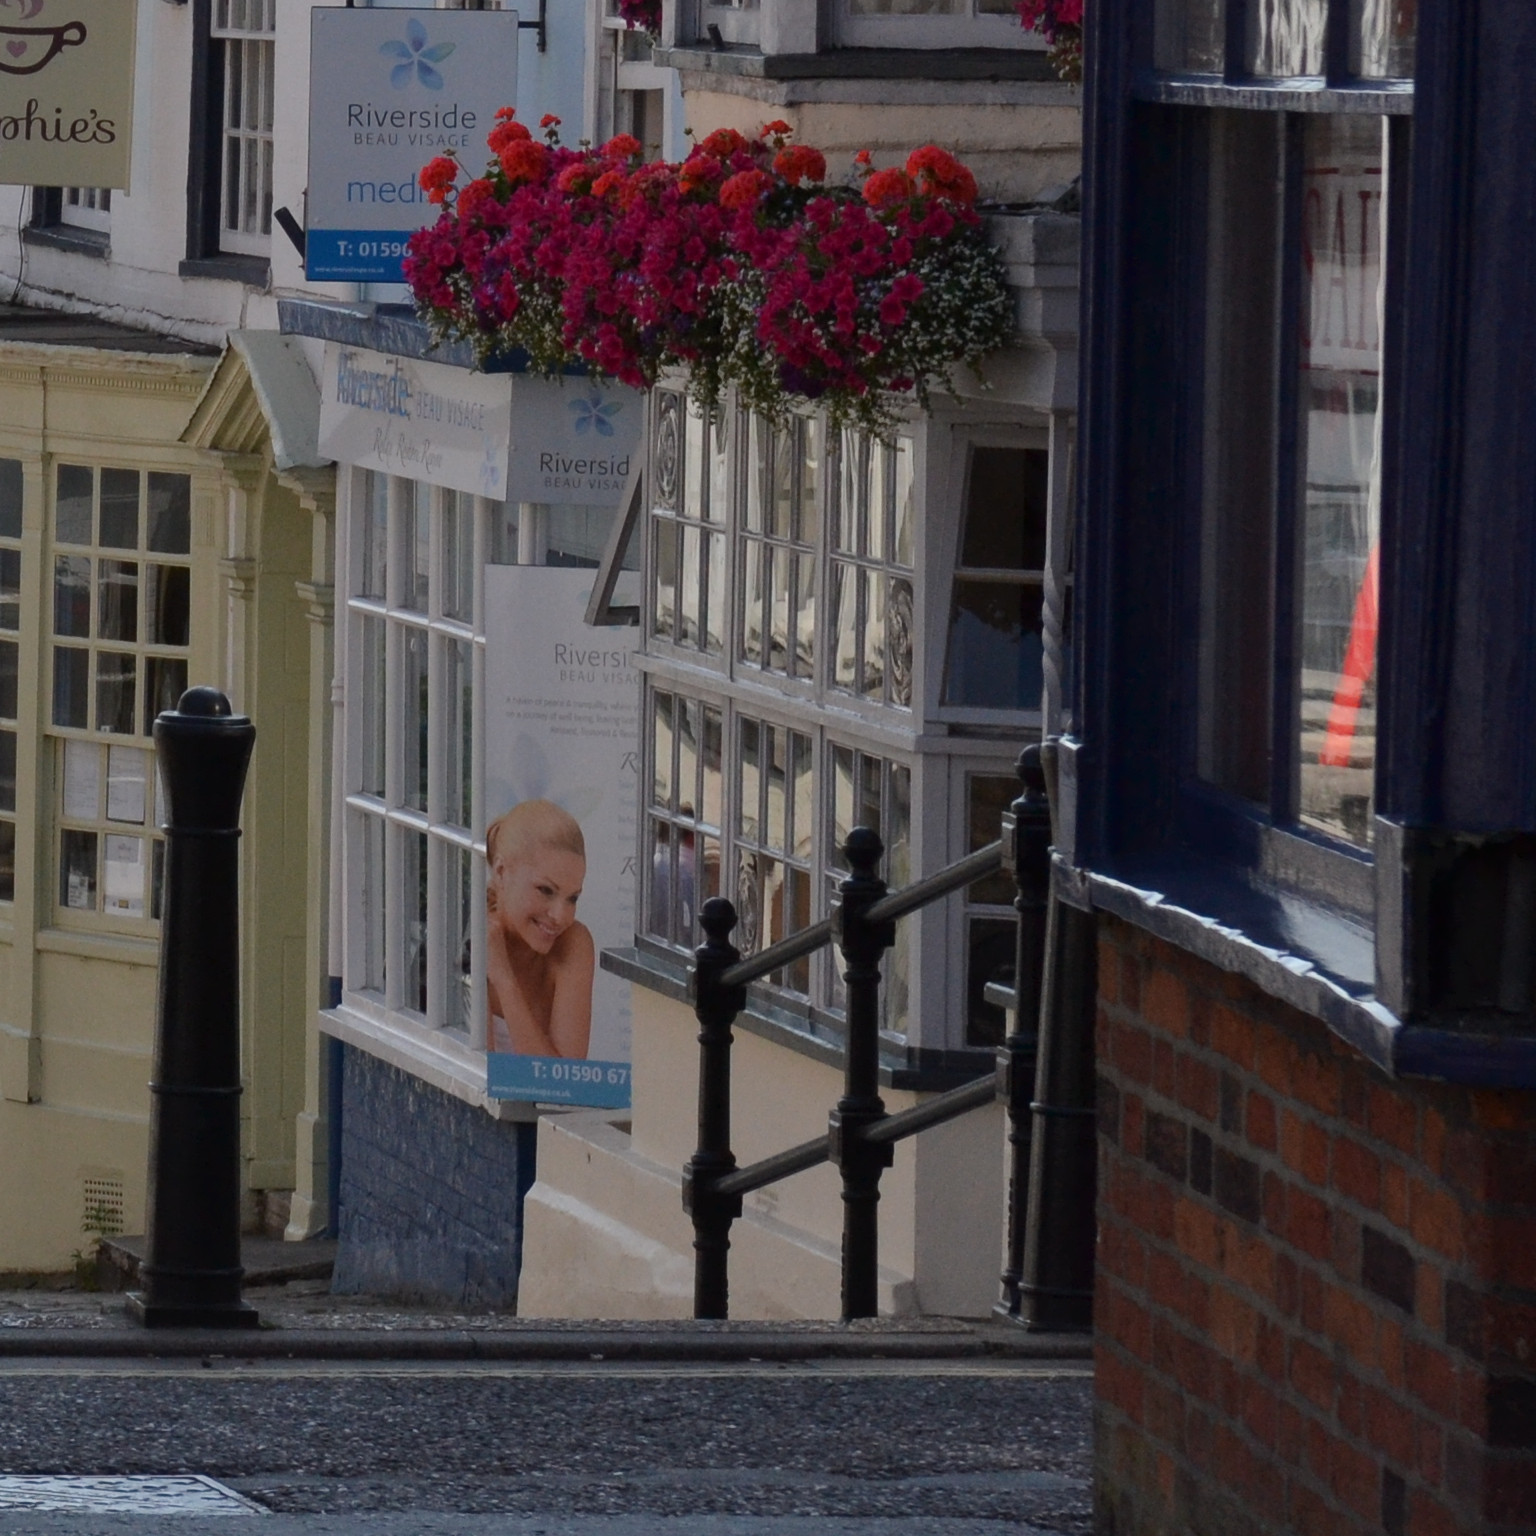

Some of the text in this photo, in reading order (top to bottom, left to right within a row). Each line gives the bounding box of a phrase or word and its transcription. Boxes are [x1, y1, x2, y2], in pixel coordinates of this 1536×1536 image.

[348, 103, 477, 130] Riverside
[354, 132, 469, 147] BEAU VISAGE
[337, 241, 353, 256] T:
[416, 391, 444, 422] BEAU
[447, 398, 485, 430] VISAGE
[540, 452, 630, 476] Riversid
[545, 477, 626, 490] BEAU VISA
[555, 643, 628, 668] Riversi
[560, 670, 641, 685] BEAU VISA
[532, 1061, 631, 1085] T: 01590 67
